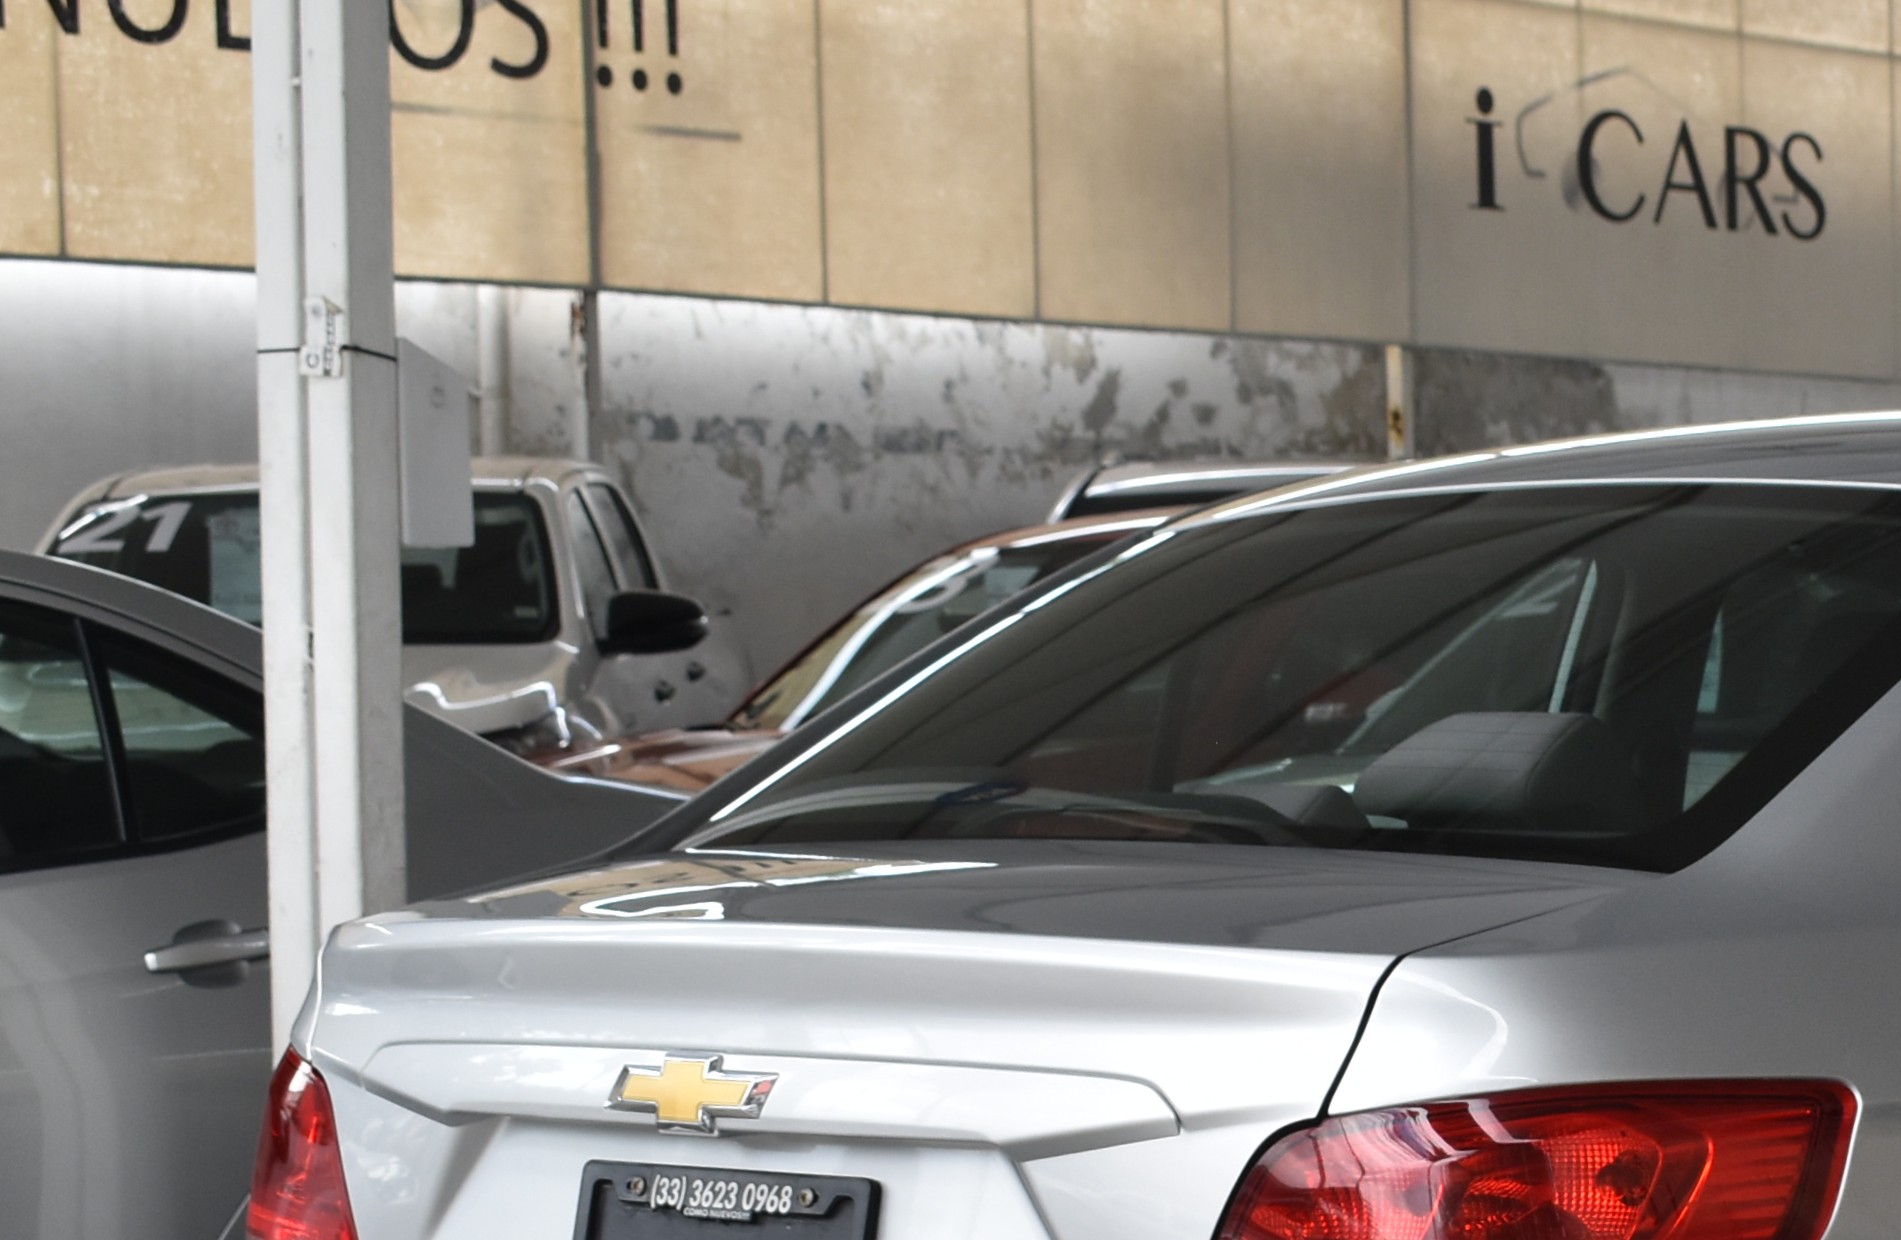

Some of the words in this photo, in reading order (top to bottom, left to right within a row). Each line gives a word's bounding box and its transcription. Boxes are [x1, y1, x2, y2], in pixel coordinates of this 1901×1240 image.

[1465, 86, 1505, 212] i
[1578, 108, 1826, 241] CARS
[650, 1174, 687, 1211] (33)
[689, 1179, 739, 1210] 3623
[742, 1183, 793, 1214] 0968
